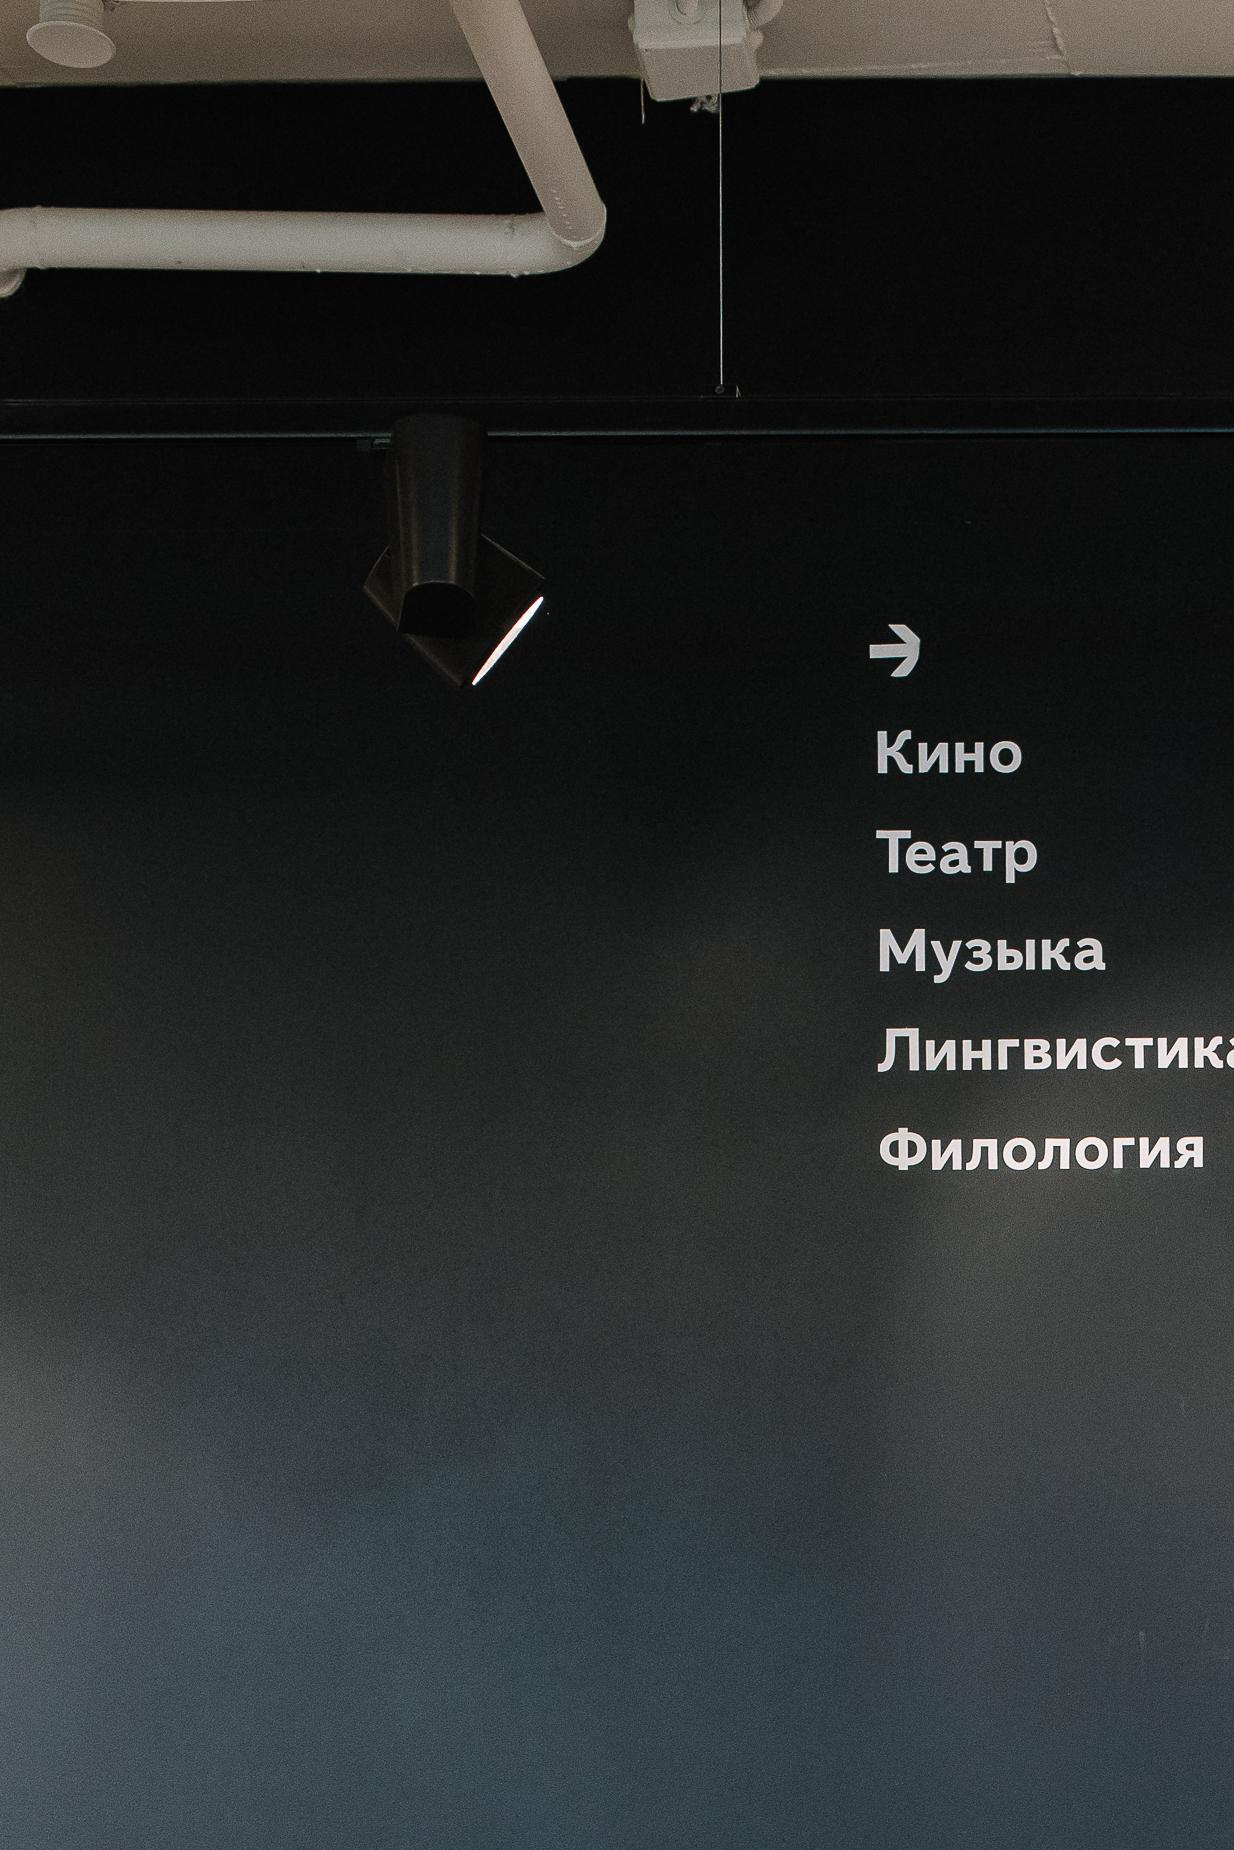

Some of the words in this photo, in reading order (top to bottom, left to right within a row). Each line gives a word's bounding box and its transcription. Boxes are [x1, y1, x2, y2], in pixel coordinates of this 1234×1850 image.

[876, 730, 1022, 774] Кино
[876, 829, 1038, 884] Театр
[879, 928, 1106, 984] Музыка
[879, 1127, 1205, 1171] Филология
